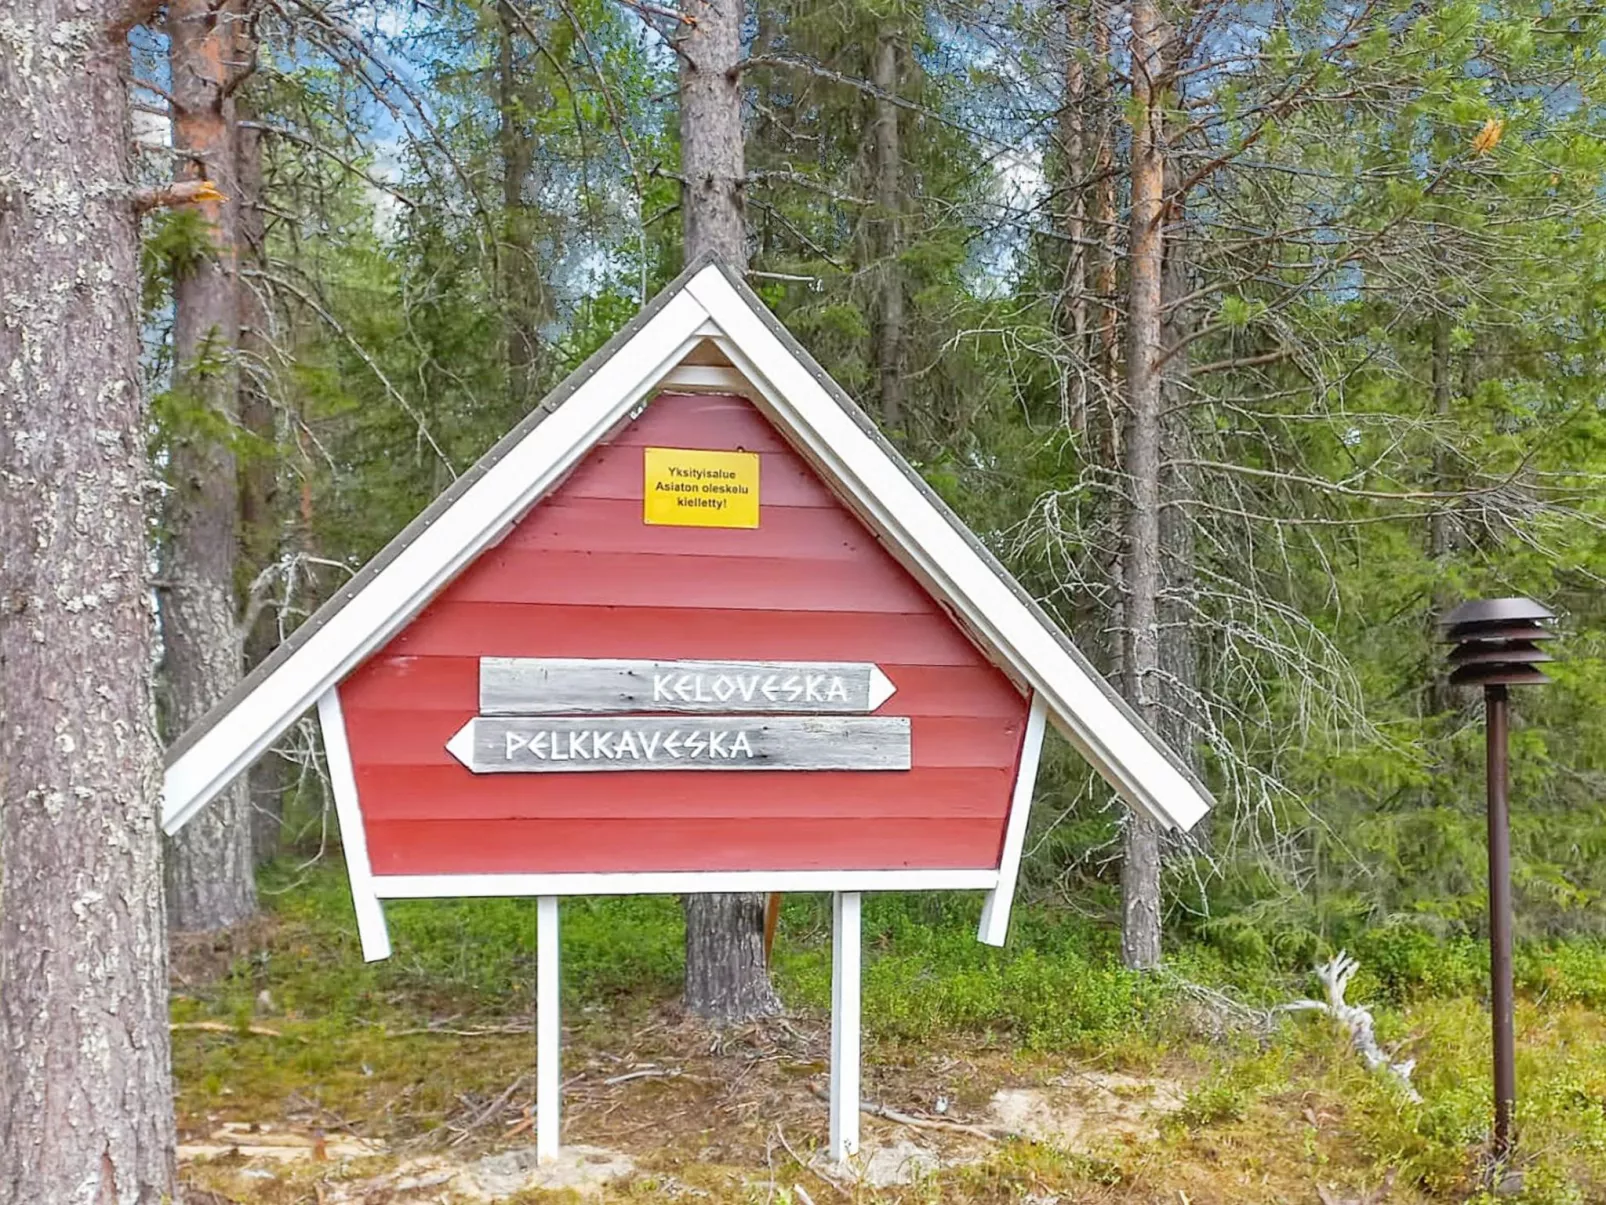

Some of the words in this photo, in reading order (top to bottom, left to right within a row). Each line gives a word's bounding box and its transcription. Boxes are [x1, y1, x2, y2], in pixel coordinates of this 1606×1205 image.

[668, 467, 736, 480] Yksityisalue
[655, 481, 699, 492] Asiaton
[702, 483, 748, 495] oleskelu
[677, 496, 727, 510] kielletty!
[652, 673, 850, 702] KELOVESKA
[504, 730, 754, 760] PELKKAVESKA
